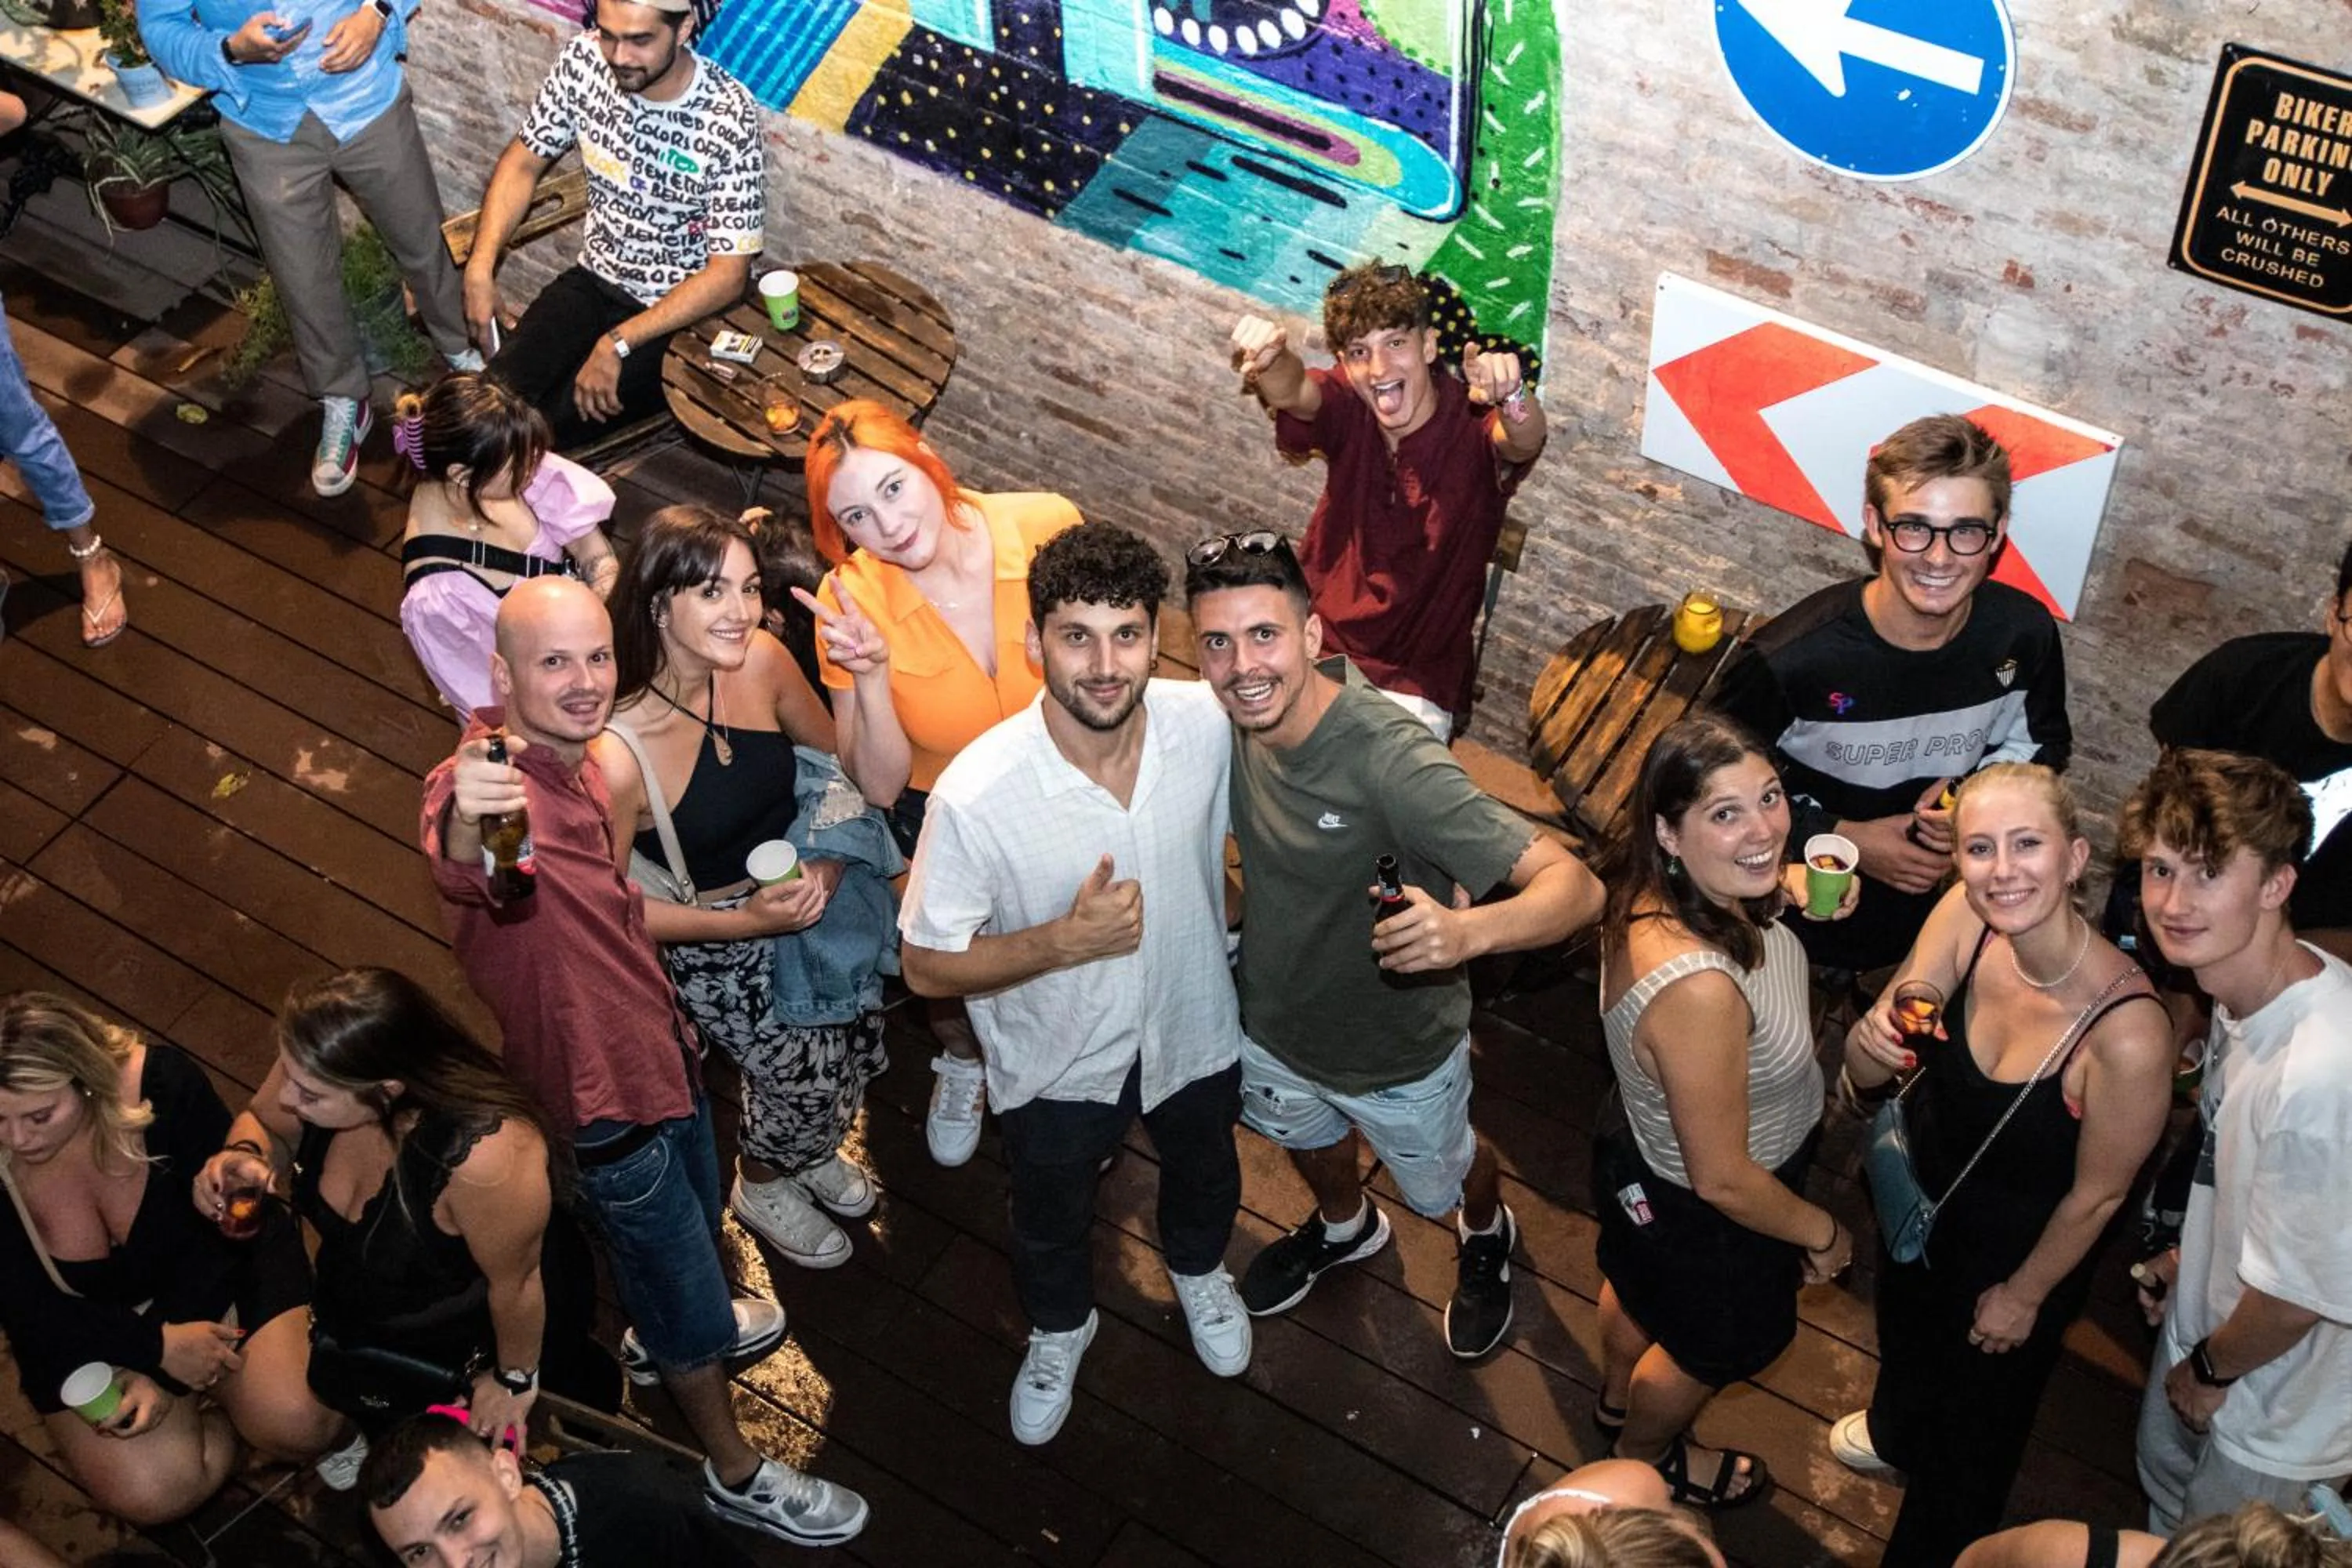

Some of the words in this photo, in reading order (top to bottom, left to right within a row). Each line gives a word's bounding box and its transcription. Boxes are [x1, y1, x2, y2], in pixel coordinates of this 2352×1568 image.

[2274, 92, 2352, 139] BIKER
[2245, 118, 2352, 172] PARKIN
[2262, 158, 2334, 197] ONLY
[2216, 205, 2254, 227] ALL
[2261, 217, 2350, 255] OTHERS
[2236, 230, 2283, 256] WILL
[2292, 247, 2321, 267] BE
[2221, 248, 2325, 288] CRUSHED
[1826, 739, 1918, 766] SUPER
